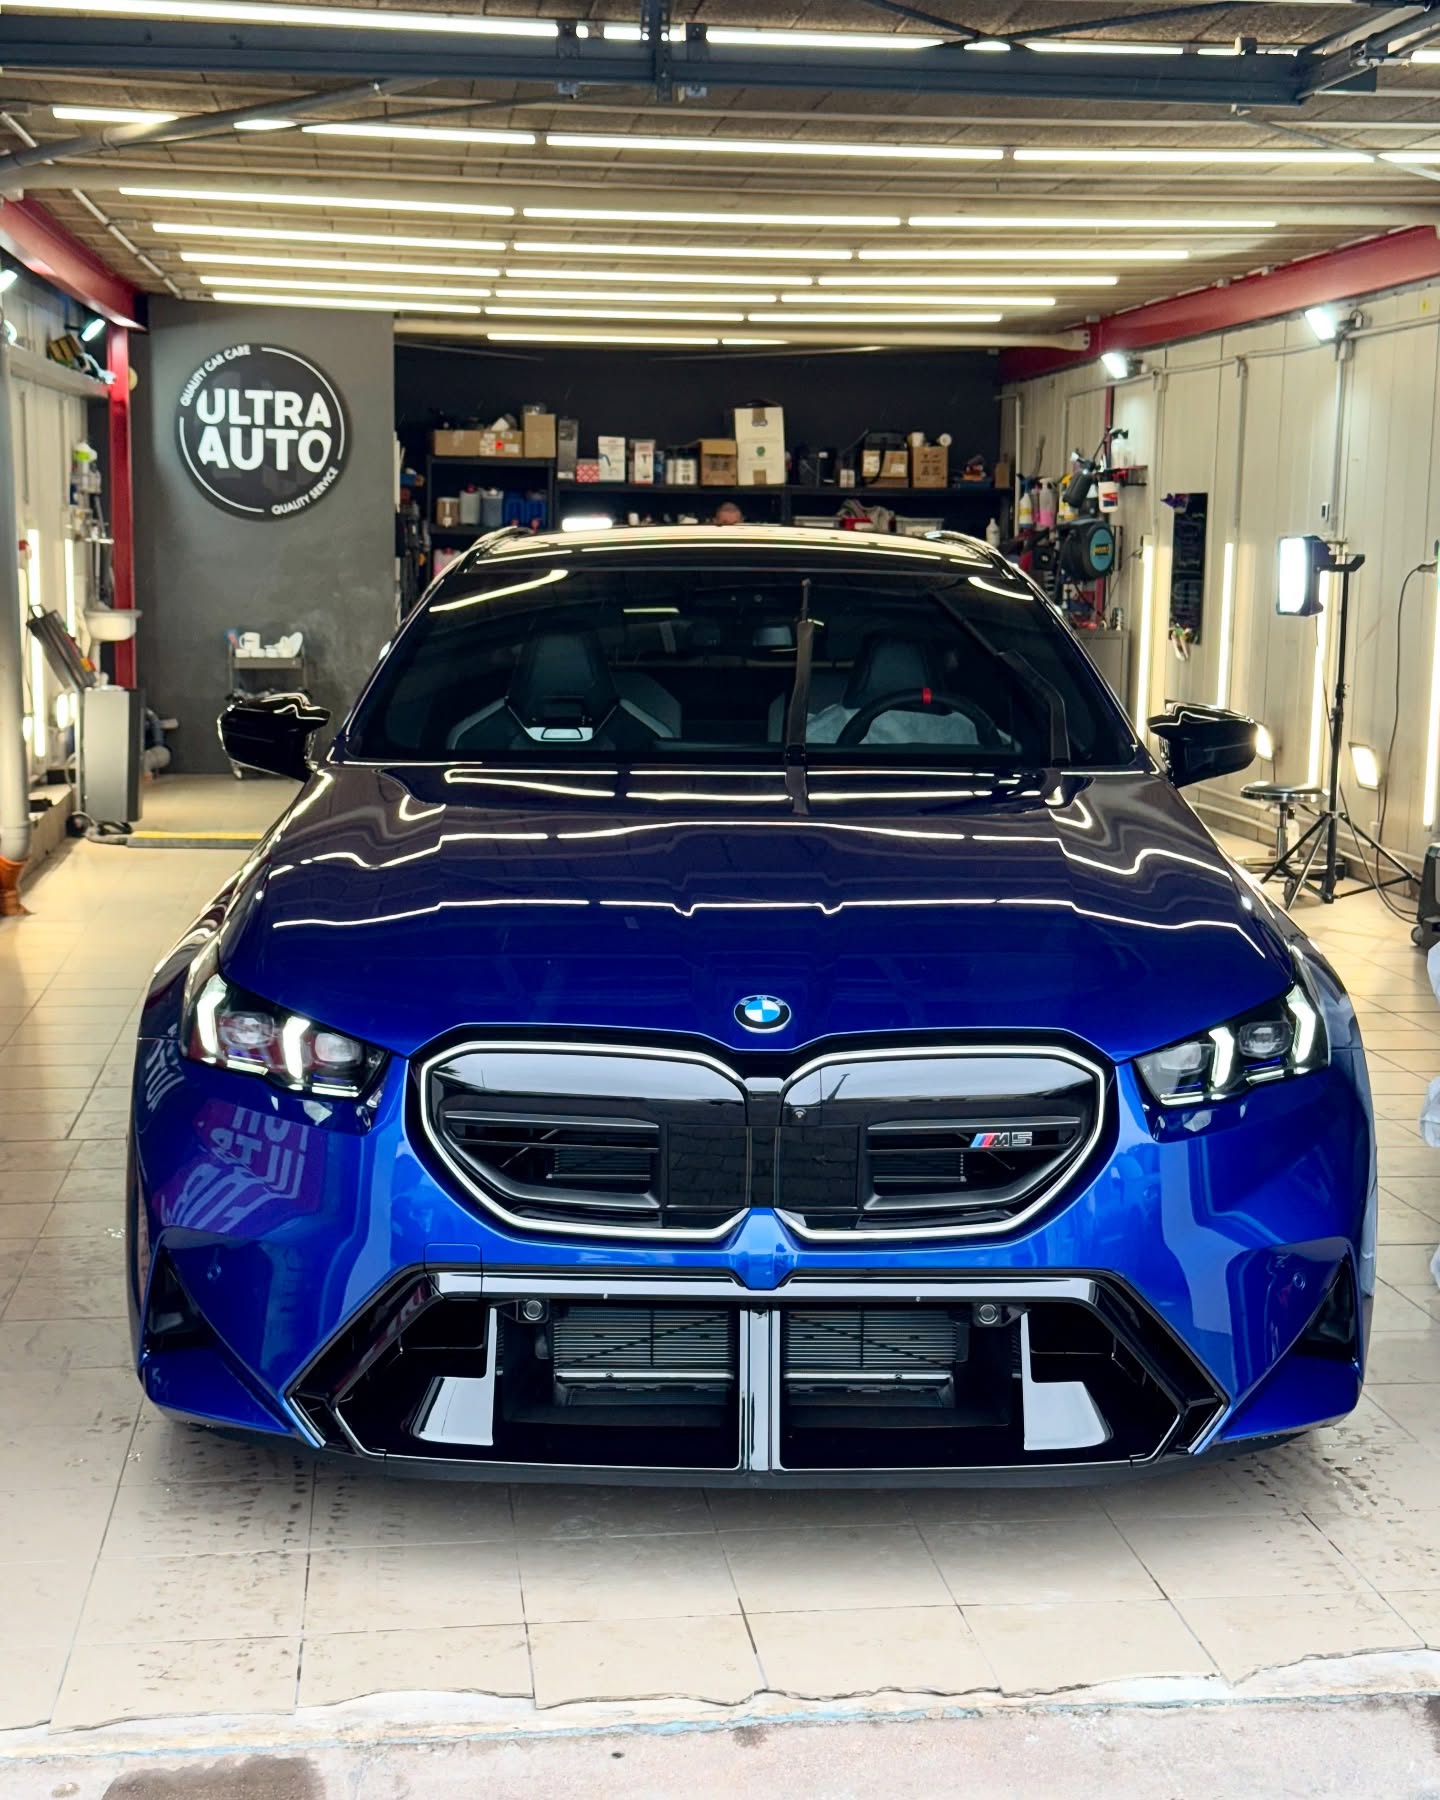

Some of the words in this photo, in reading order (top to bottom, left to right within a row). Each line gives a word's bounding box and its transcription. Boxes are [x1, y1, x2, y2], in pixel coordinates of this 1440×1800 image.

[180, 366, 208, 407] QUALITY
[204, 354, 226, 372] CAR
[223, 344, 251, 361] CARE
[196, 388, 332, 428] ULTRA
[197, 426, 332, 473] AUTO
[271, 495, 311, 515] QUALITY
[309, 466, 338, 500] SERVICE
